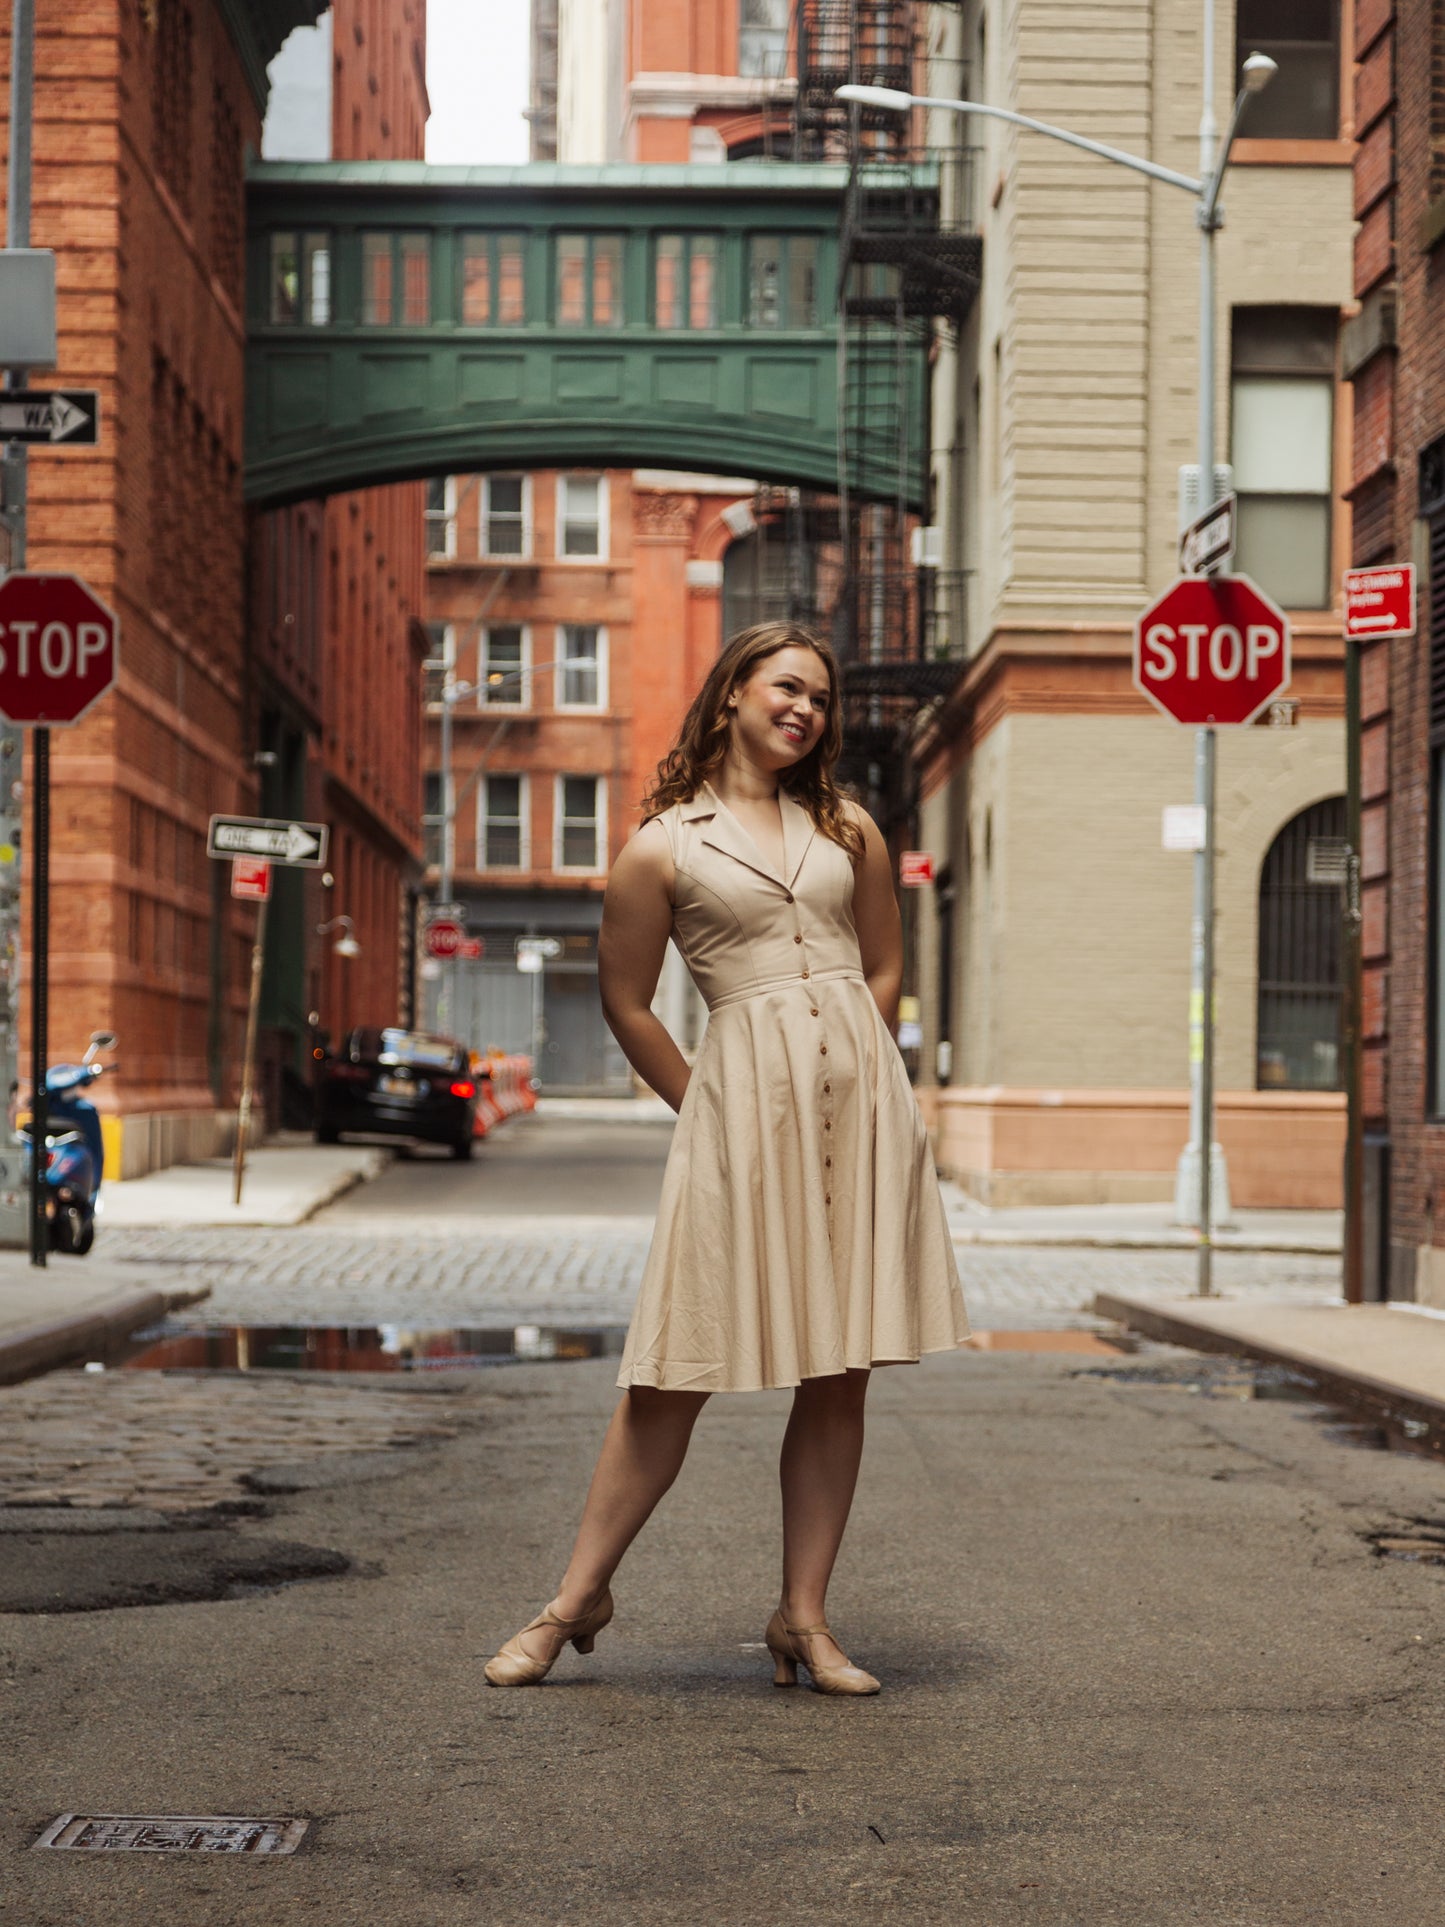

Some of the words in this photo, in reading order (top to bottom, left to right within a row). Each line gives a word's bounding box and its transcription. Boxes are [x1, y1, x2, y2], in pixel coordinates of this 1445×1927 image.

[23, 404, 73, 430] WAY
[0, 621, 107, 679] TOP
[1144, 624, 1280, 682] STOP
[224, 826, 252, 850] ONE
[267, 829, 299, 853] WAY
